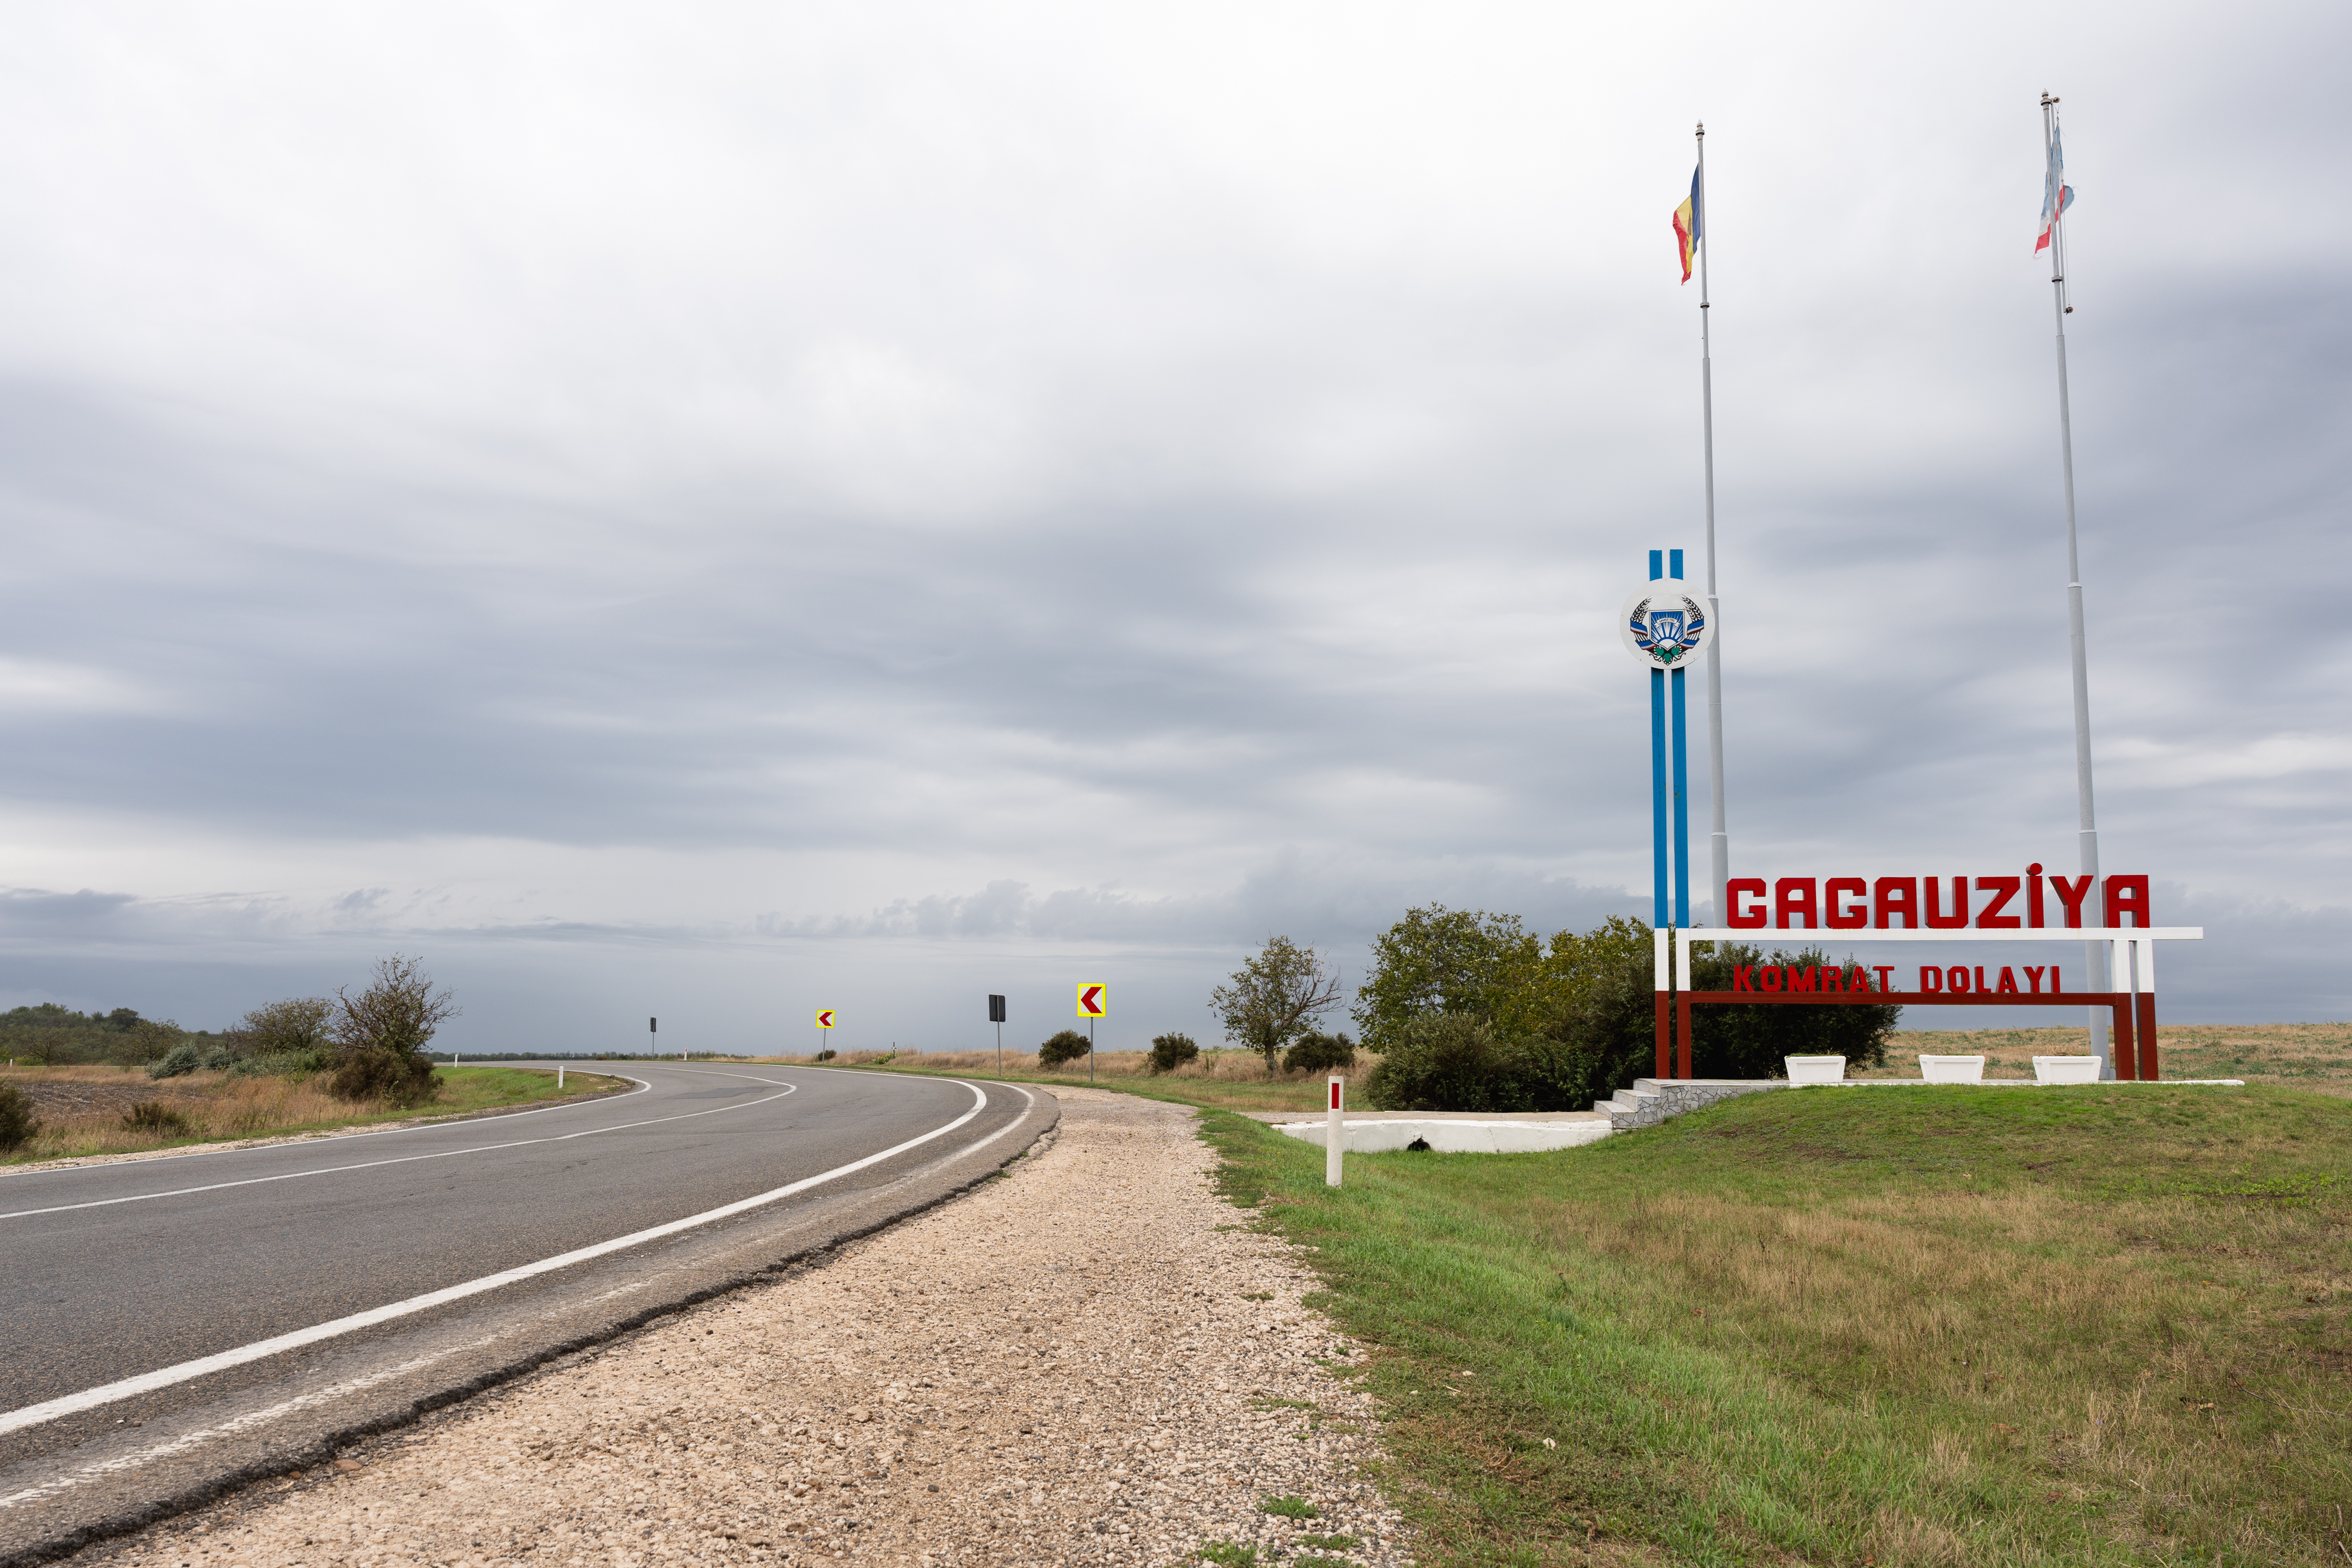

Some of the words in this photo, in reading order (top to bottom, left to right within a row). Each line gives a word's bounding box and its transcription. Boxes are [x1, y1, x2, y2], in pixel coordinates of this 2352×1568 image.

[1726, 862, 2150, 929] GAGAUZİYA
[1734, 965, 1895, 992] KOMRAT
[1919, 966, 2060, 993] DOLAYI
